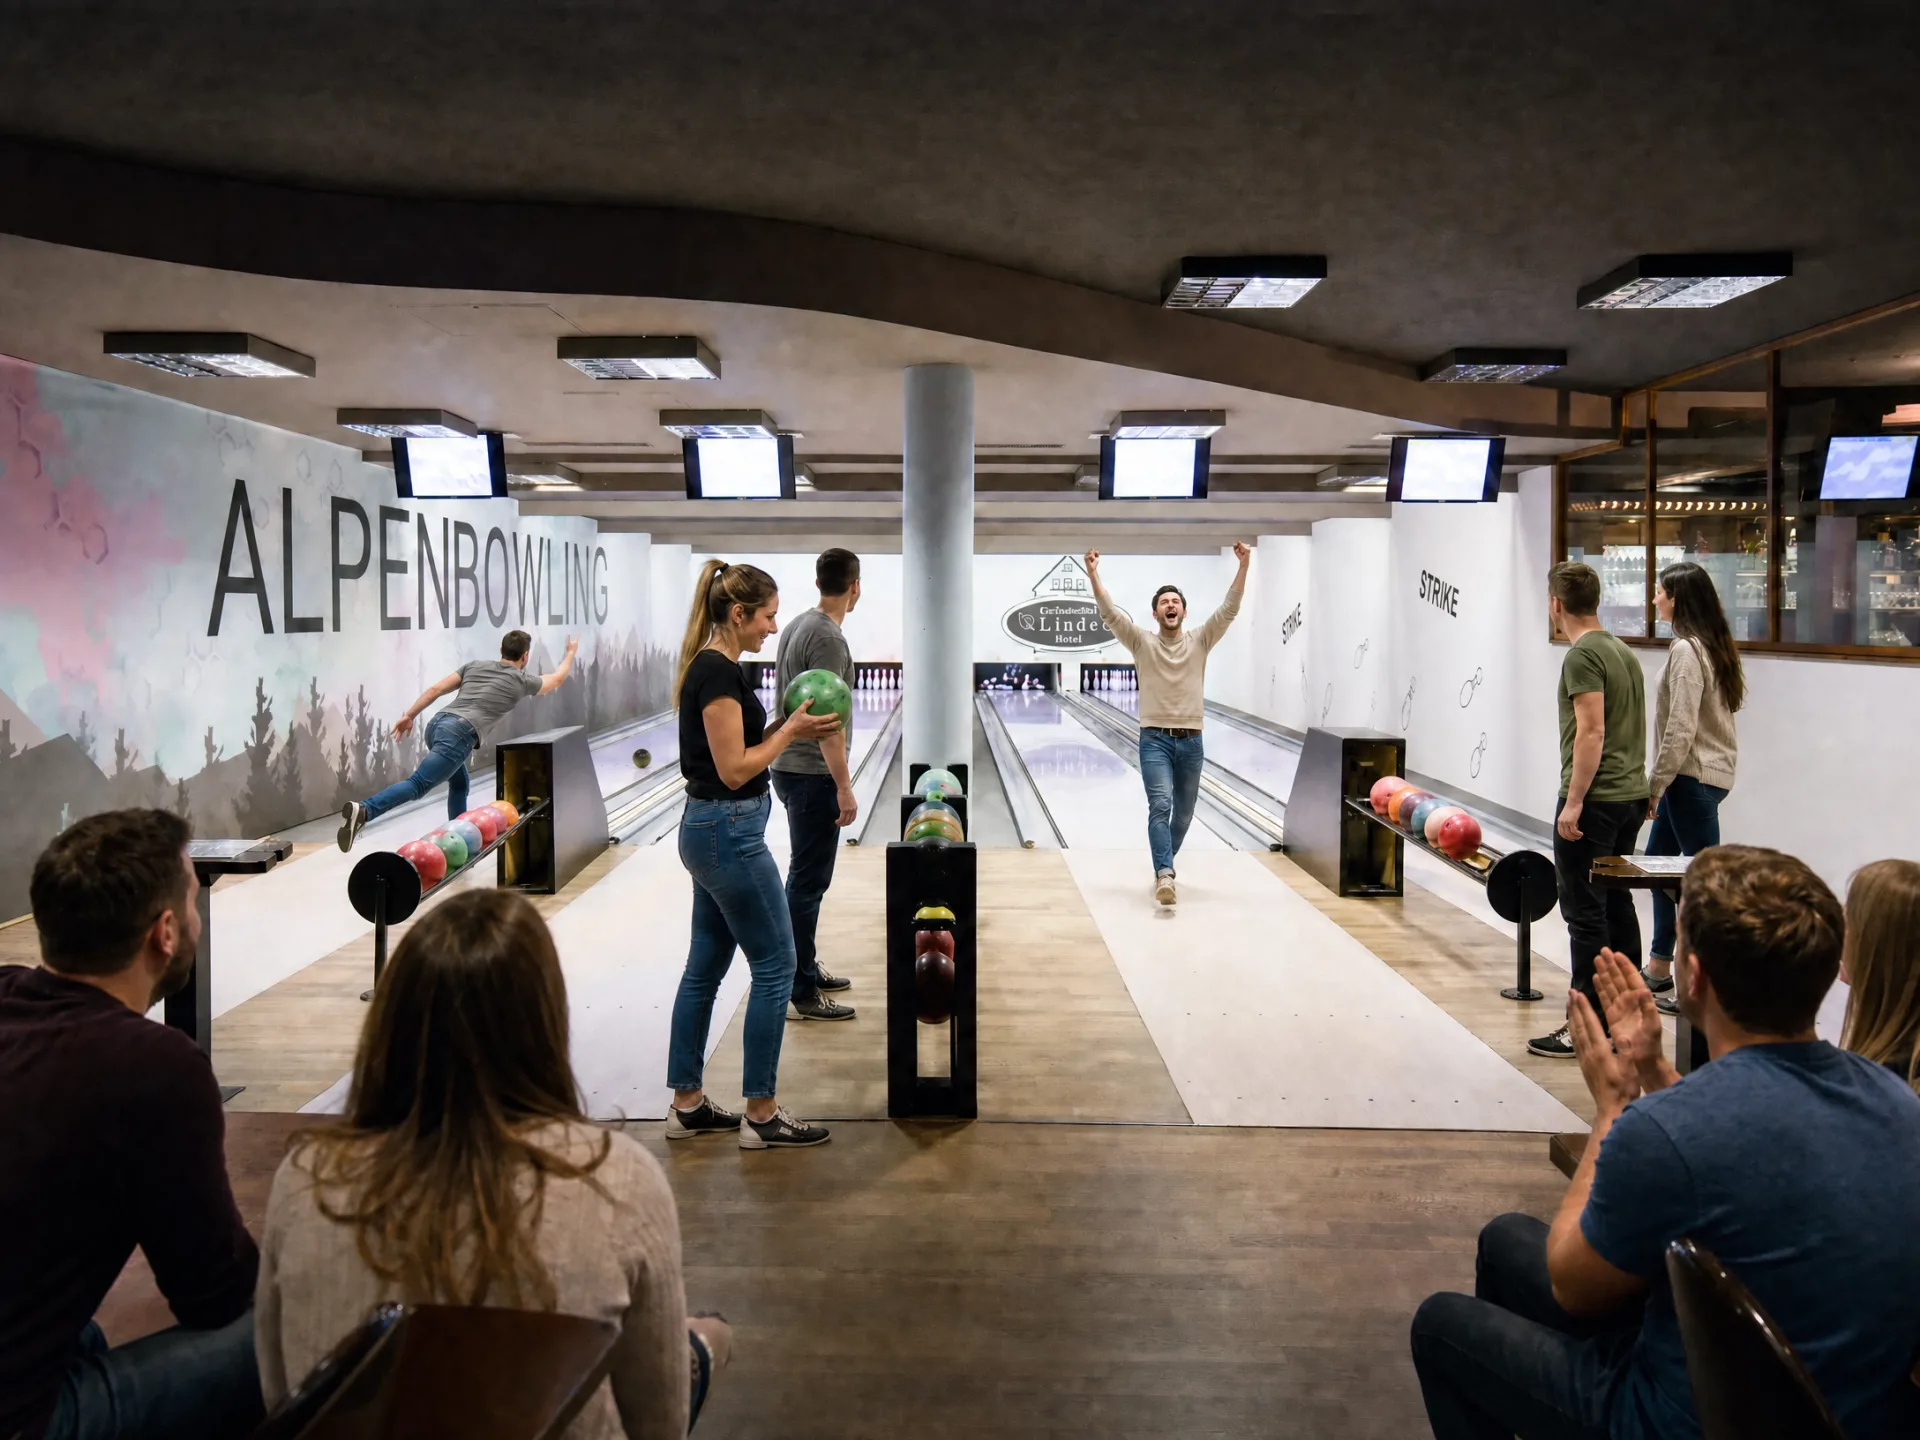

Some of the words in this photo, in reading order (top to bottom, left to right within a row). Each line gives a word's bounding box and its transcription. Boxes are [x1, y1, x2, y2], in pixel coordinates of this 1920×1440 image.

[207, 479, 608, 636] ALPENBOWLING
[1419, 569, 1459, 618] STRIKE
[1055, 634, 1082, 643] Hotel
[1282, 603, 1302, 645] STRIKE
